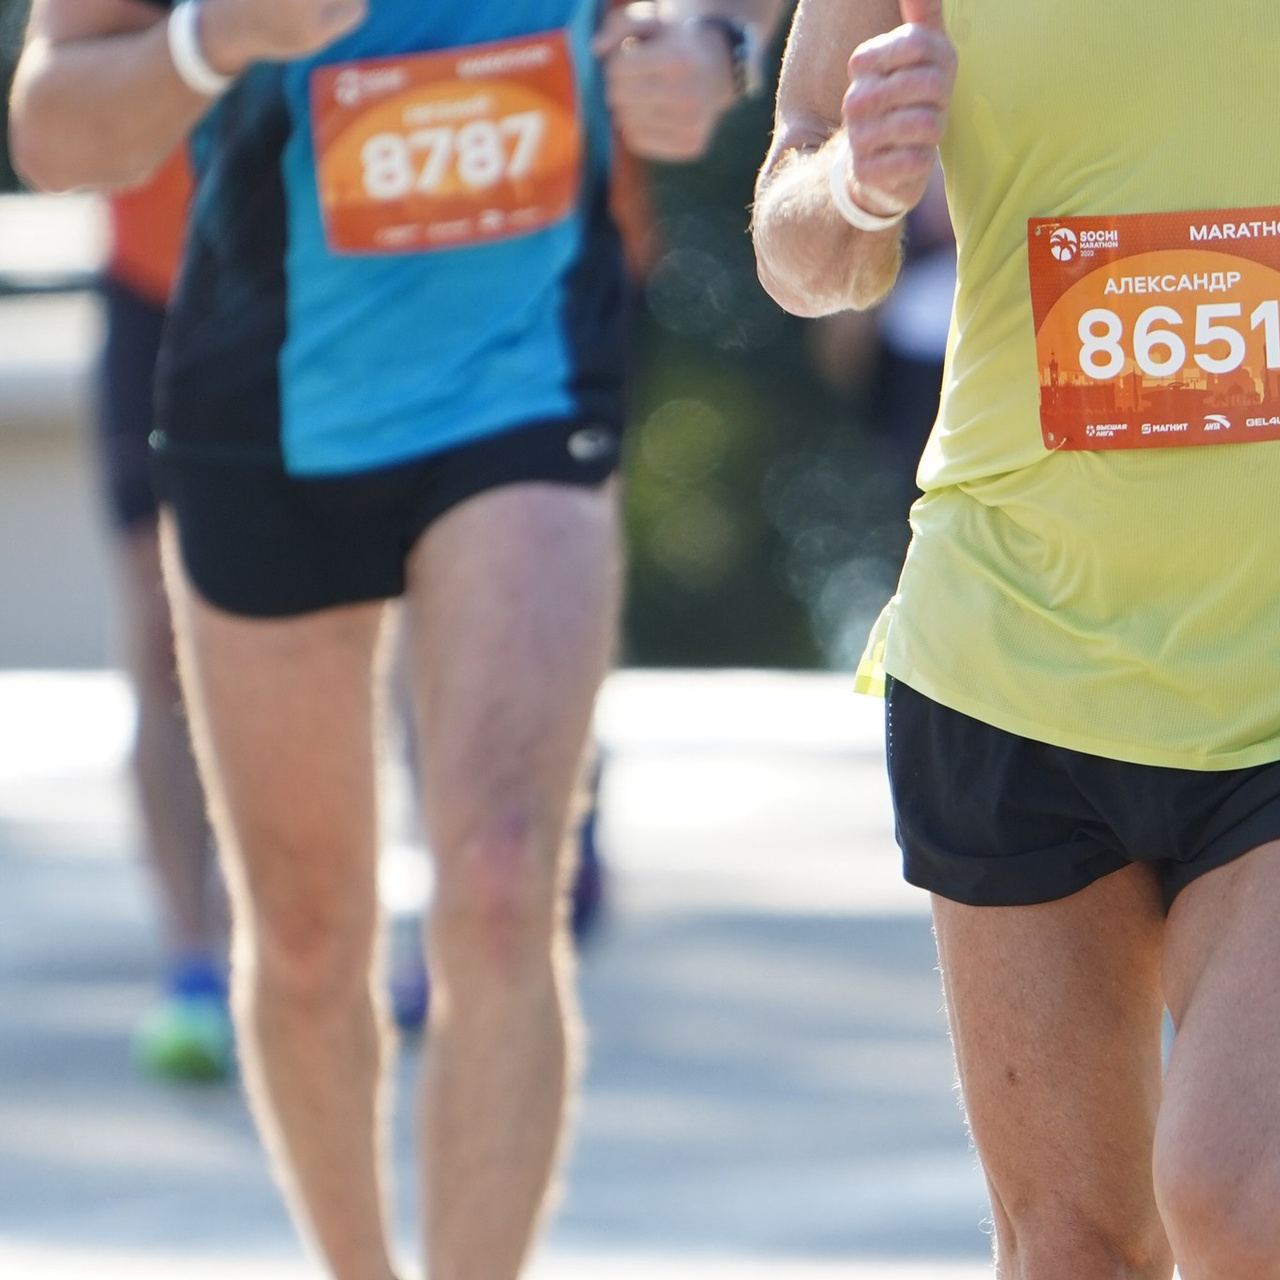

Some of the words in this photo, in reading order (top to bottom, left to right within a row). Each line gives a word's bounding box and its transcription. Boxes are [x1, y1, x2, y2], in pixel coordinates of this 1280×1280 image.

[360, 111, 543, 200] 8787
[1080, 230, 1118, 241] SOCHI
[1080, 241, 1118, 249] MARATHON
[1103, 271, 1241, 295] АЛЕКСАНДР
[1152, 423, 1188, 433] МАГНИТ
